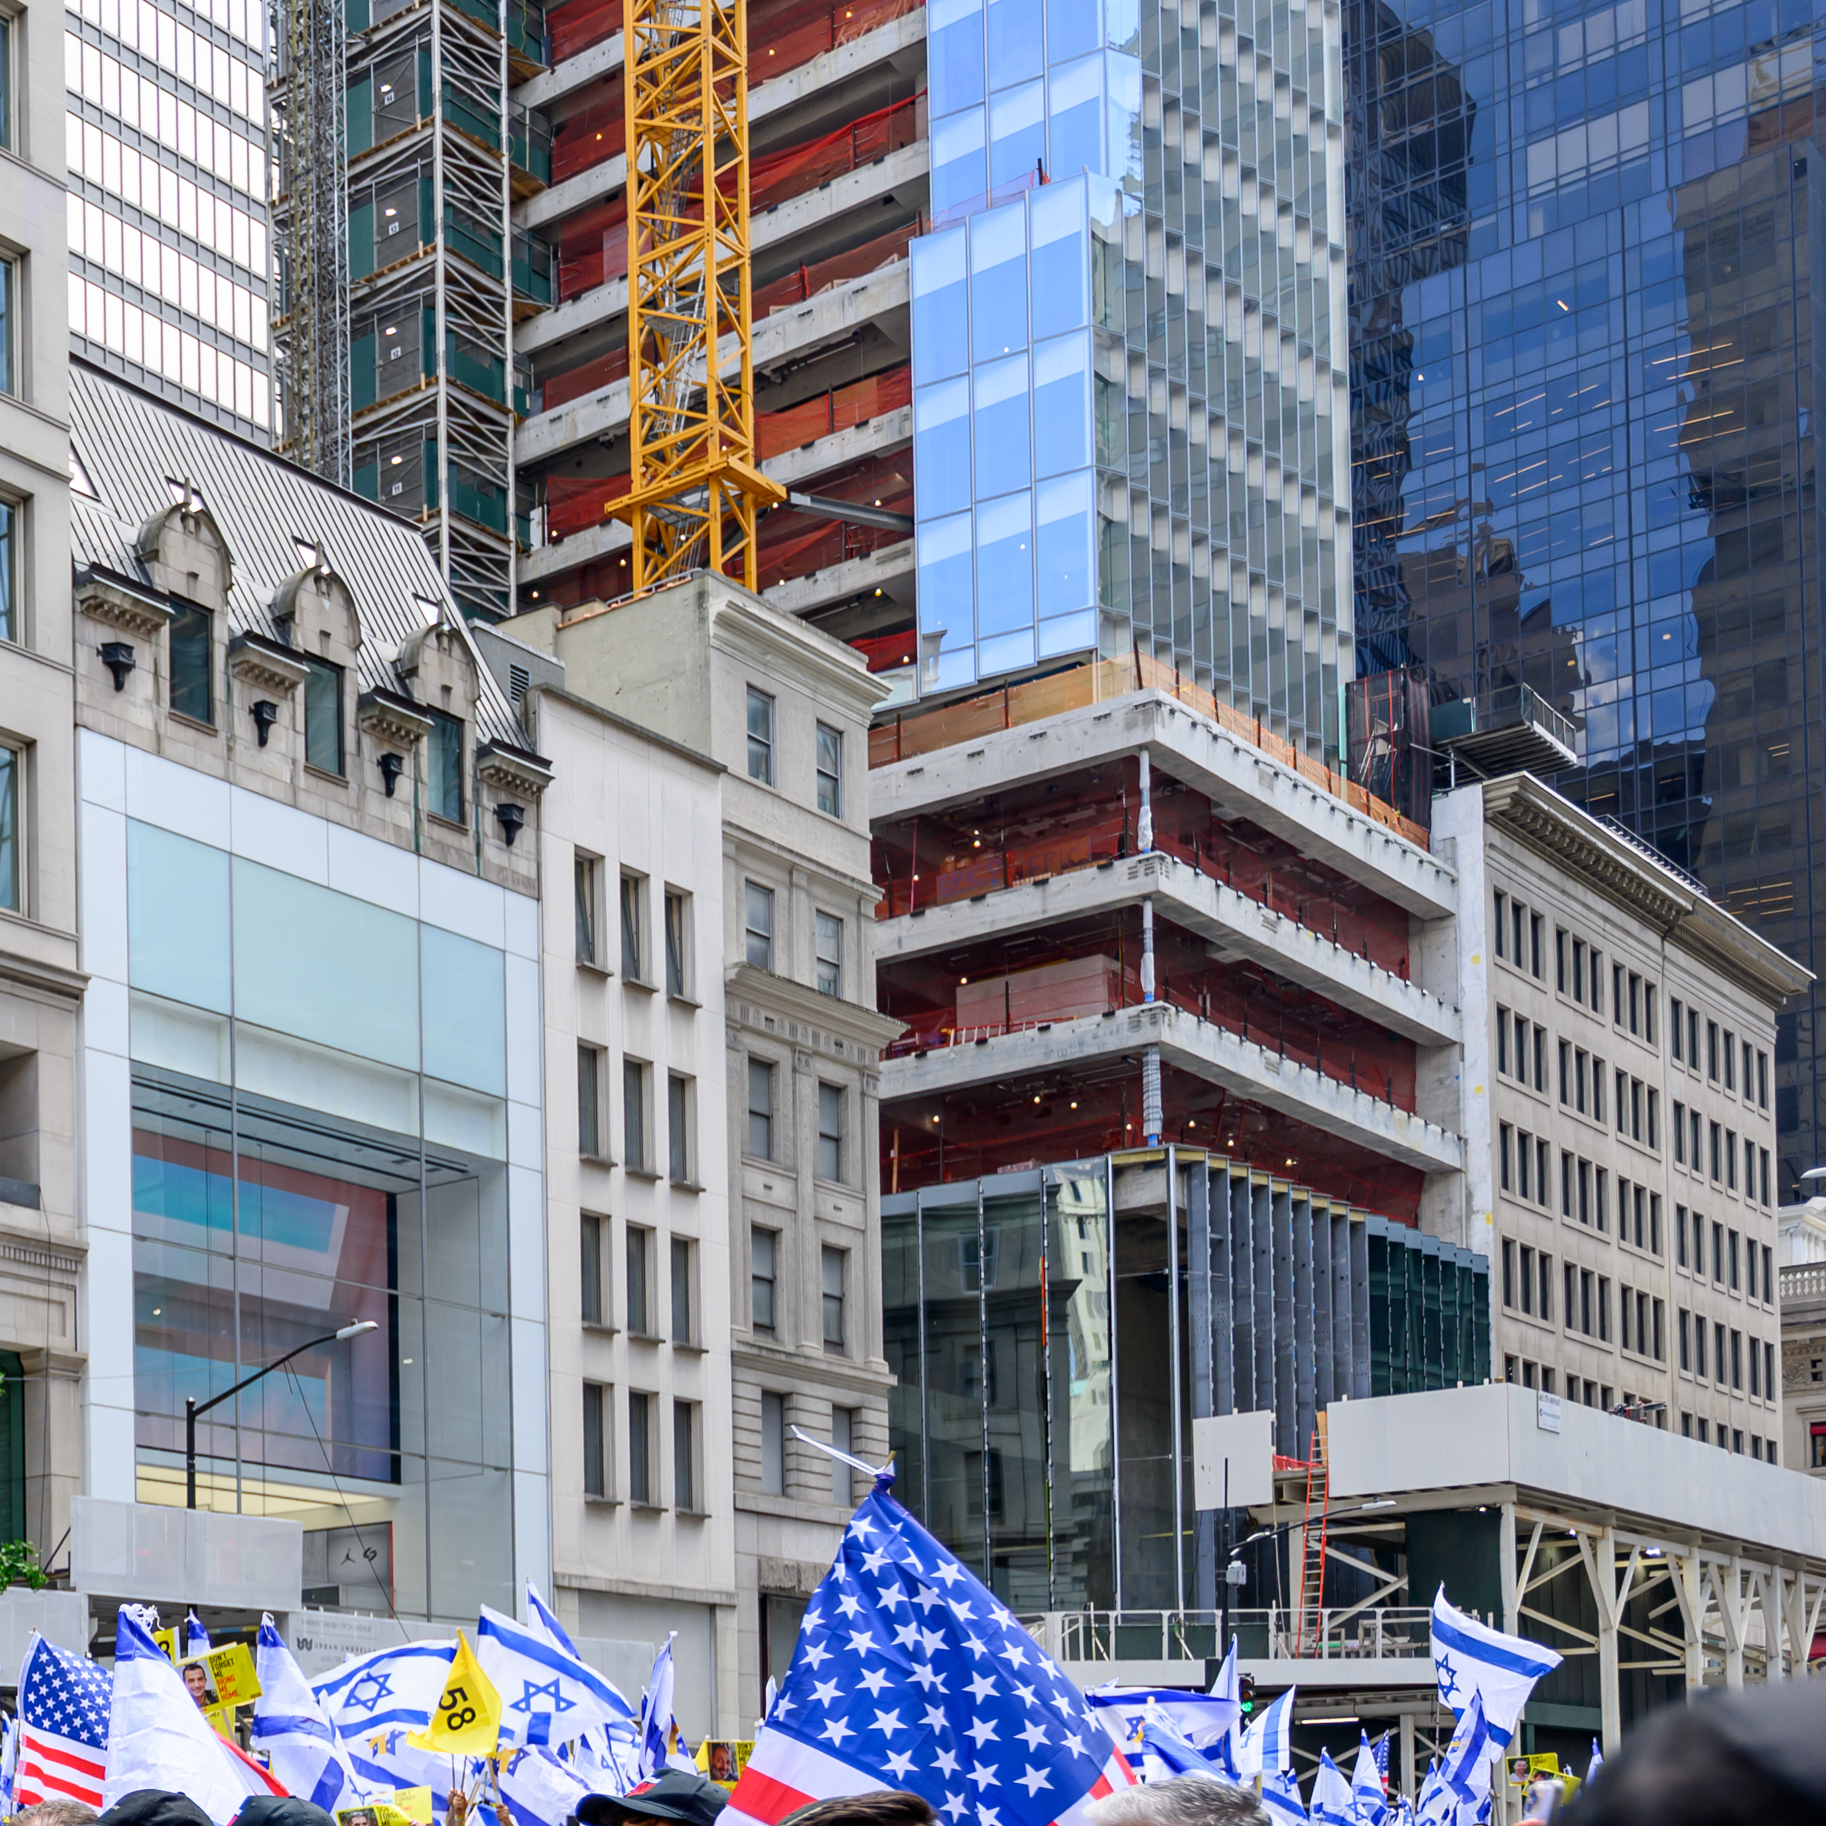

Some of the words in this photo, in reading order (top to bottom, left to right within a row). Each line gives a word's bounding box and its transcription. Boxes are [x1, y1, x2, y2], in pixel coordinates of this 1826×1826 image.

[314, 1642, 338, 1651] URBAN
[209, 1652, 227, 1663] DON'T
[211, 1658, 234, 1671] FORGET
[213, 1670, 223, 1678] ME
[216, 1674, 235, 1687] BRING
[218, 1685, 228, 1693] ME
[439, 1686, 476, 1732] 58
